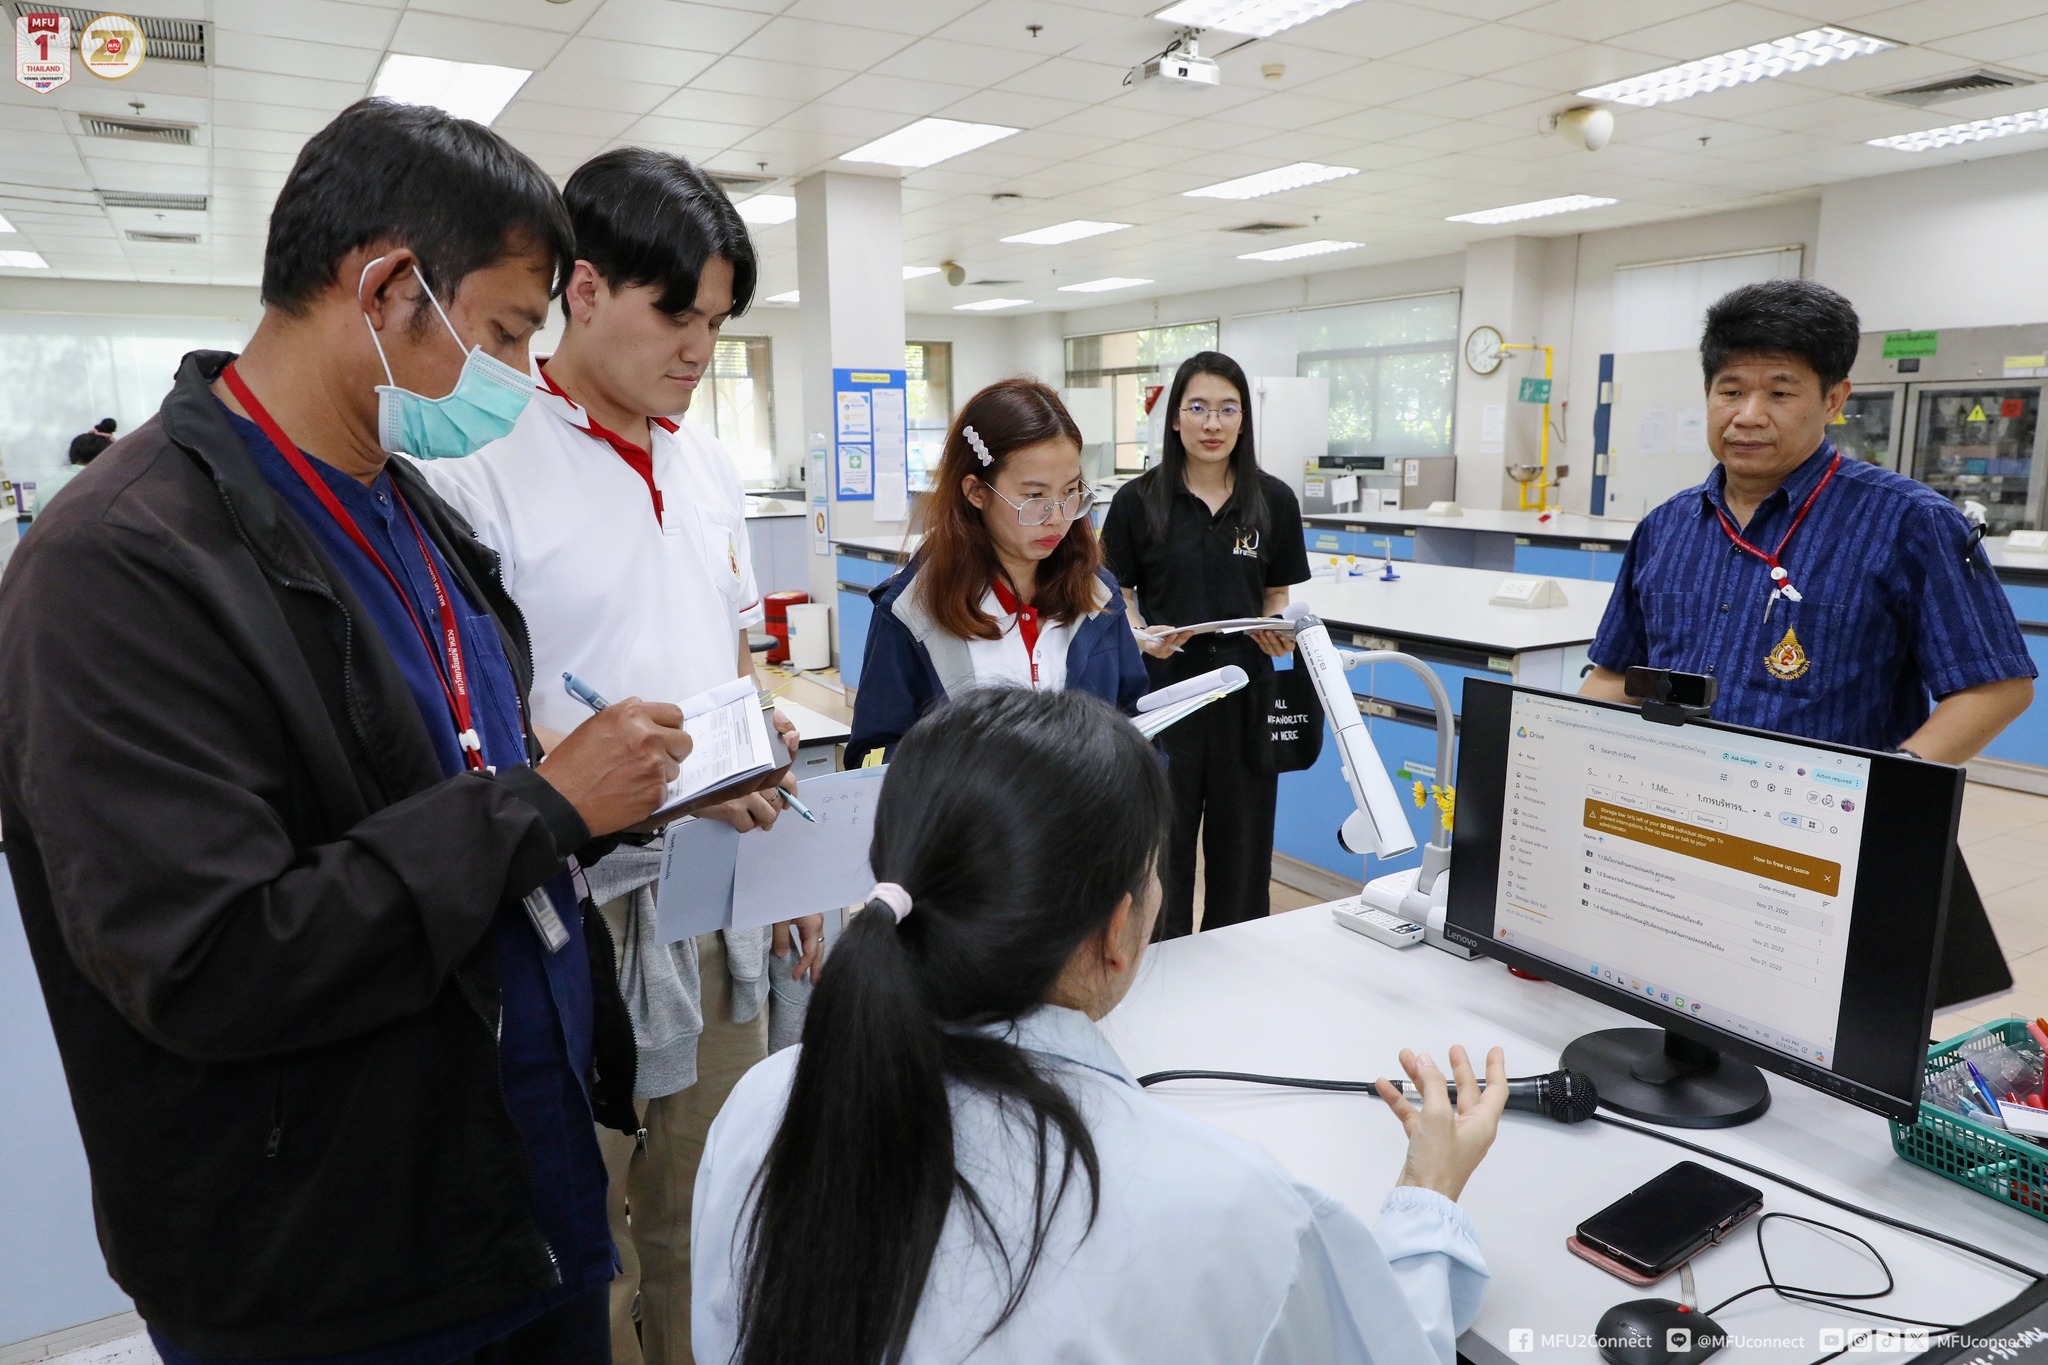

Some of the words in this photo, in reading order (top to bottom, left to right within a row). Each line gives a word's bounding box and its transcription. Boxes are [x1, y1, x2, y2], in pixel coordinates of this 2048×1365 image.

[1274, 699, 1287, 709] ALL
[1280, 730, 1299, 741] HERE
[1529, 730, 1545, 741] Drive
[1600, 747, 1617, 757] Search
[1623, 752, 1637, 761] Drive
[1730, 754, 1739, 762] Ask
[1739, 756, 1757, 766] Google
[1816, 772, 1831, 781] Action
[1831, 776, 1852, 785] required
[1591, 788, 1602, 796] Type
[1620, 796, 1636, 805] People
[1655, 804, 1677, 815] Modified
[1600, 807, 1617, 816] Storage
[1674, 826, 1697, 837] individual
[1697, 831, 1716, 843] storage.
[1696, 815, 1714, 824] Source
[1599, 814, 1616, 823] prevent
[1616, 818, 1644, 831] interruptions,
[1660, 830, 1674, 840] space
[1599, 820, 1628, 834] administrator.
[1583, 833, 1596, 841] Name
[1753, 855, 1766, 863] How
[1772, 861, 1785, 869] free
[1792, 866, 1810, 876] space
[1758, 883, 1772, 892] Date
[1772, 886, 1796, 898] modified
[1756, 901, 1767, 909] Nov
[1775, 907, 1789, 916] 2022
[1754, 920, 1765, 928] Nov
[1773, 925, 1787, 934] 2022
[1446, 928, 1478, 947] Lenovo
[1752, 938, 1763, 946] Nov
[1770, 944, 1785, 953] 2022
[1750, 956, 1760, 964] Nov
[1768, 962, 1782, 971] 2022
